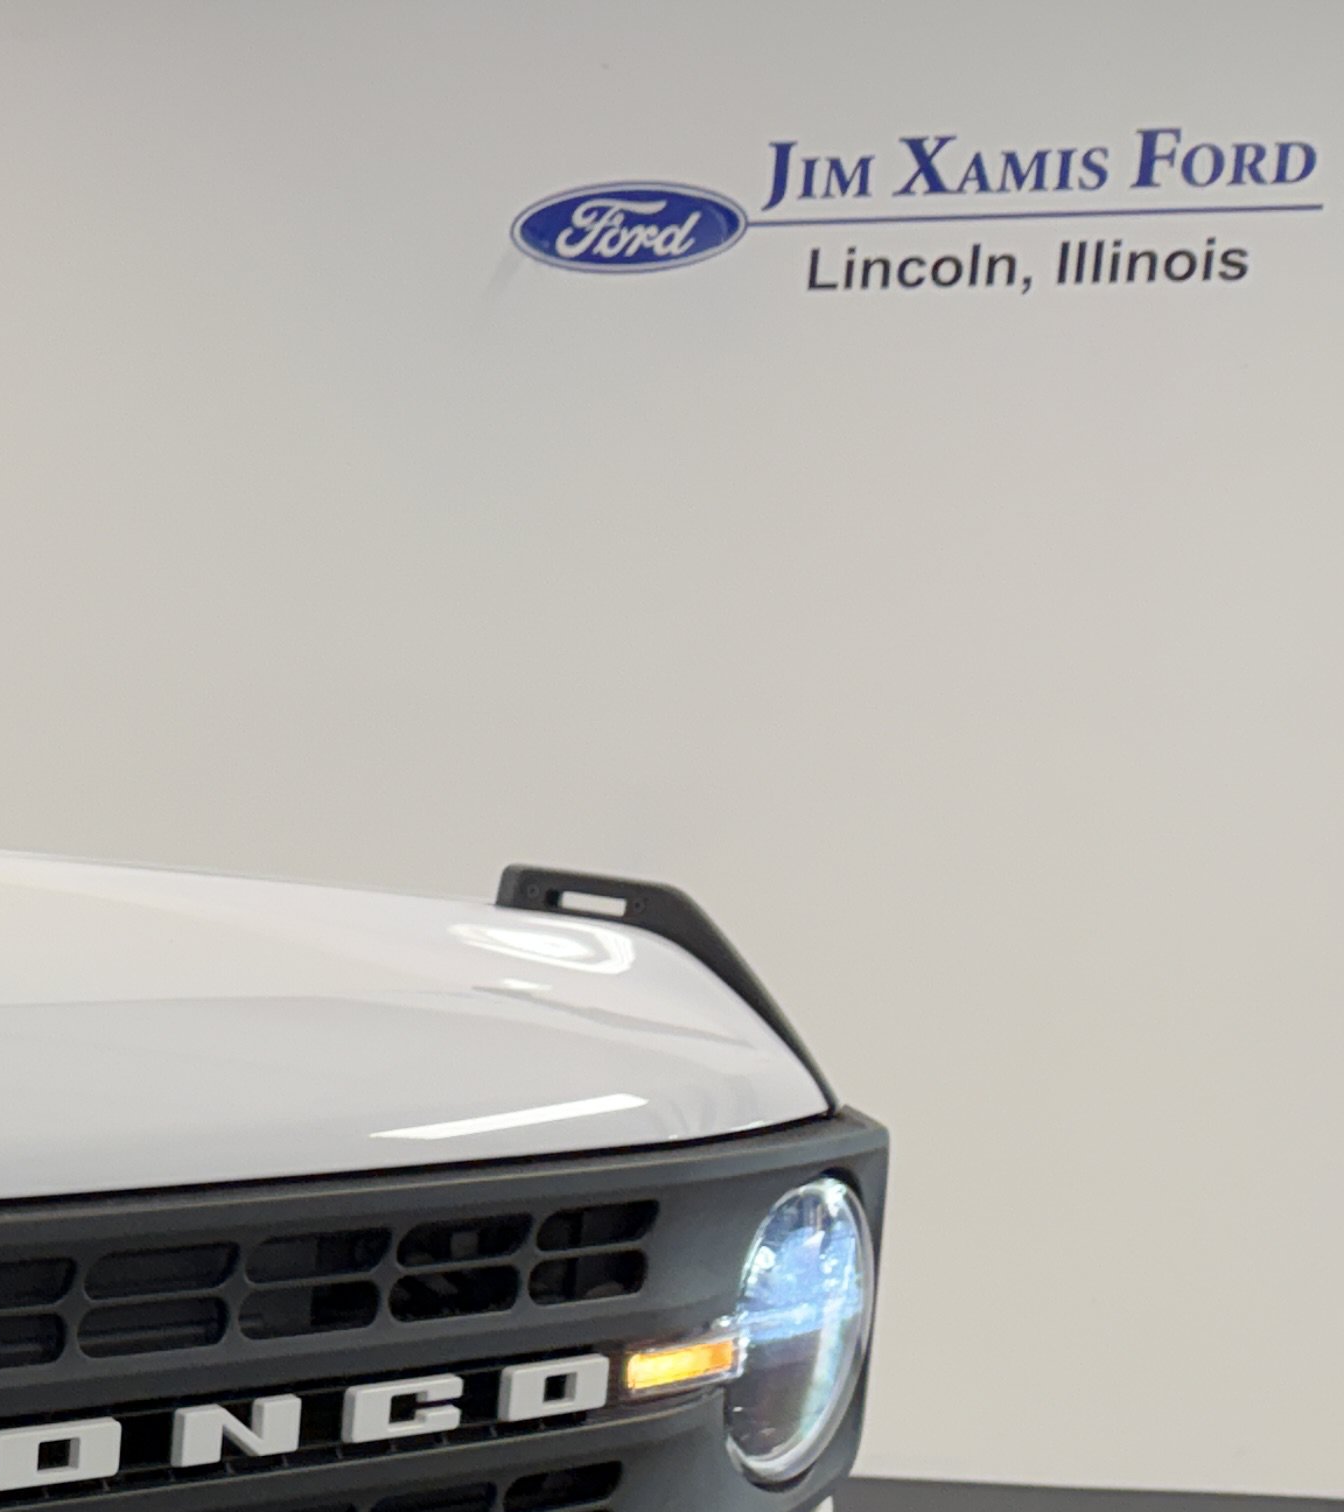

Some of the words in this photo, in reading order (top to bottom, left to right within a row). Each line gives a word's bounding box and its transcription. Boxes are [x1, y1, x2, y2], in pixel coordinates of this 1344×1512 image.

[761, 140, 875, 212] JIM
[892, 134, 1109, 197] XAMIS
[1130, 127, 1317, 188] FORD
[555, 198, 701, 258] Ford
[807, 242, 1033, 295] Lincoln,
[1056, 237, 1249, 284] Illinois
